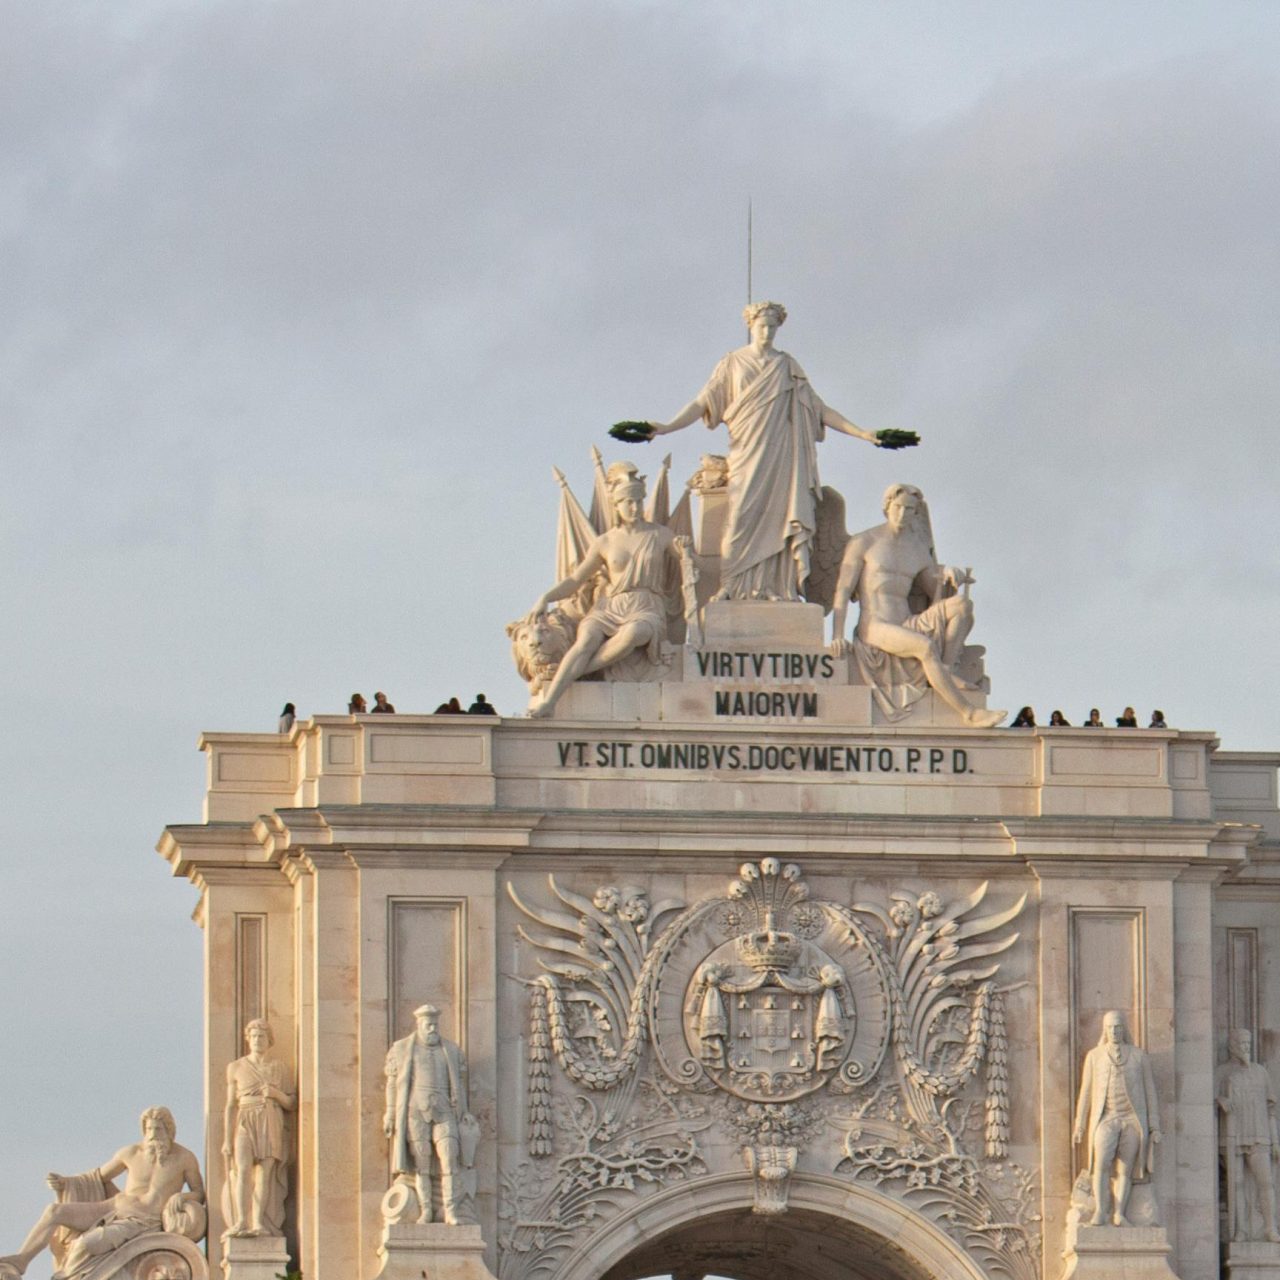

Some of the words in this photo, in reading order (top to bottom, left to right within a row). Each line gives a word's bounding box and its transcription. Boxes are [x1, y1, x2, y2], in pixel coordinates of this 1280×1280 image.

[696, 651, 834, 678] VIRTVTIBVS
[715, 691, 818, 717] MAIORVM
[596, 743, 634, 768] SIT.
